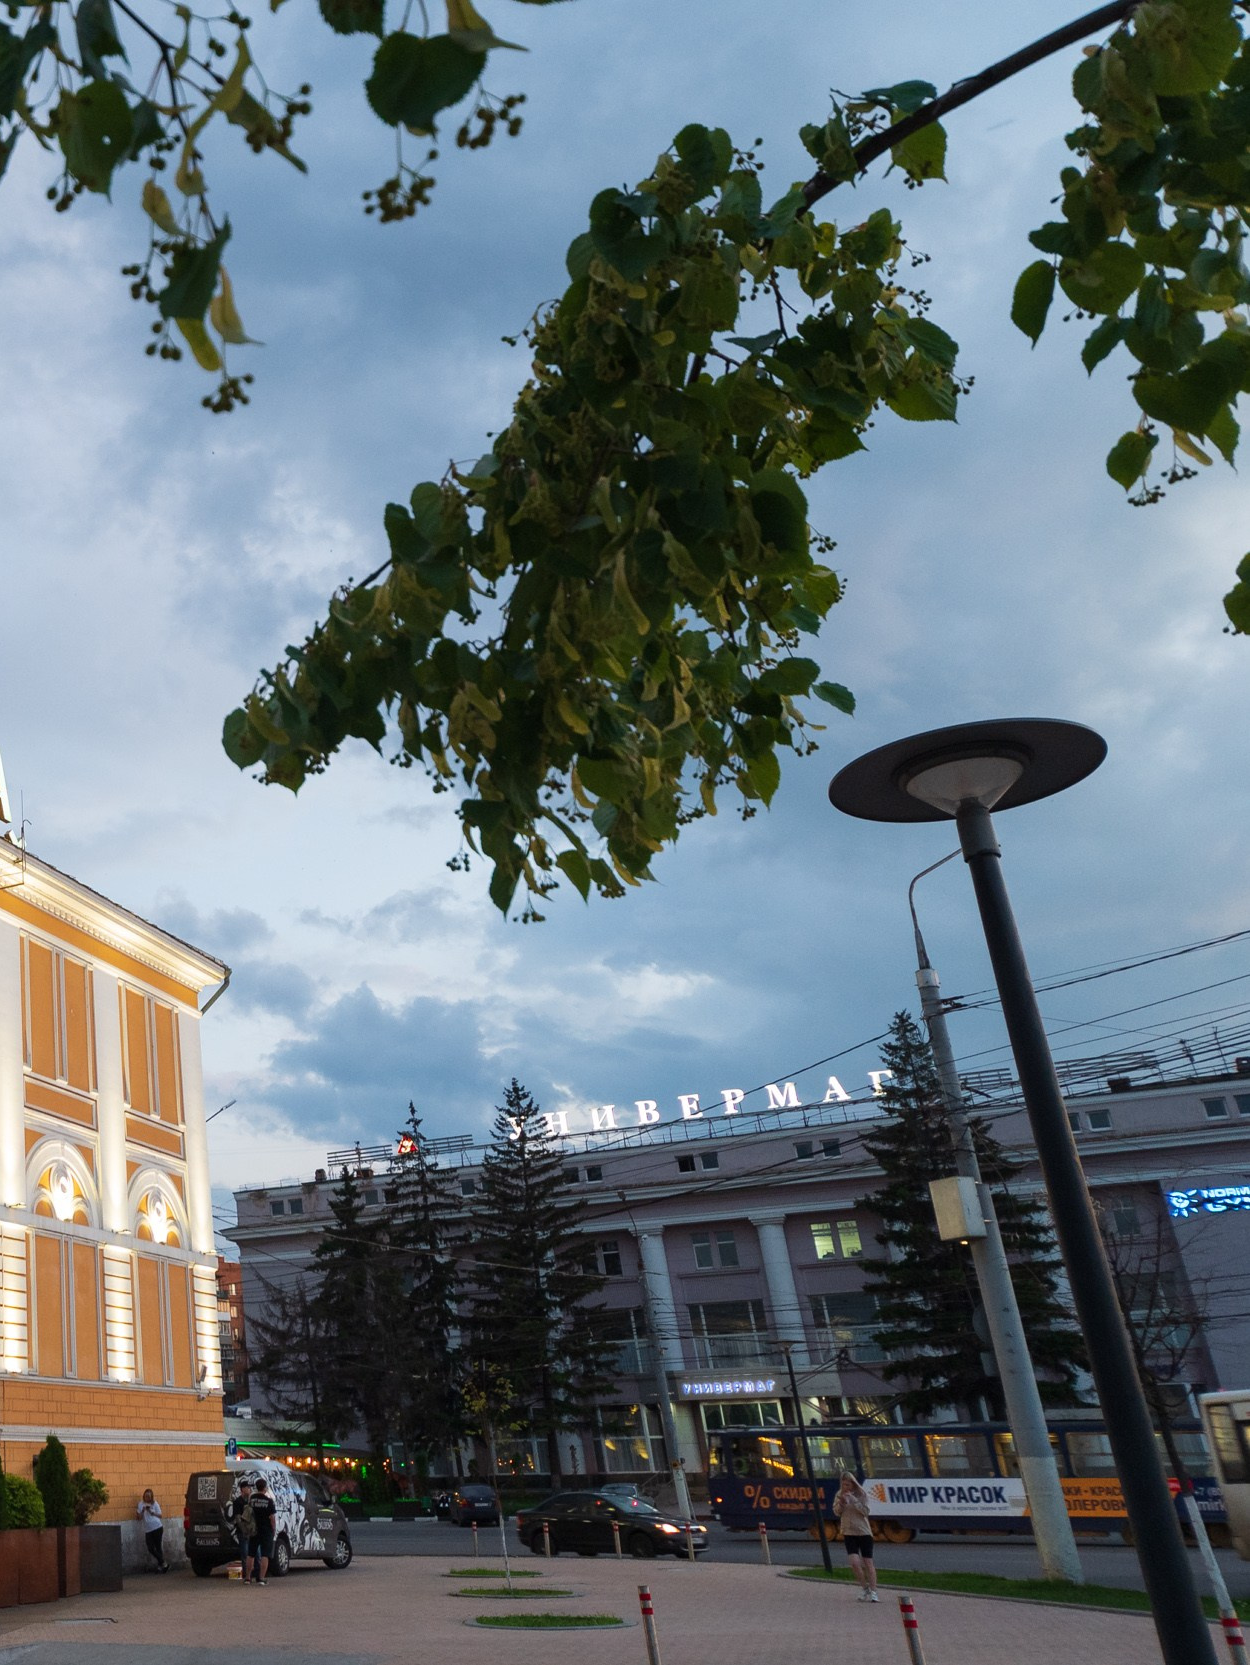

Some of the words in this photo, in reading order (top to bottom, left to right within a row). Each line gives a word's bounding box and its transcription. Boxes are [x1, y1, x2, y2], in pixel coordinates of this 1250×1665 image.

[682, 1379, 776, 1395] УНИВЕРМАГ
[743, 1485, 770, 1509] %
[888, 1486, 928, 1504] МИР
[931, 1486, 1007, 1504] КРАСОК
